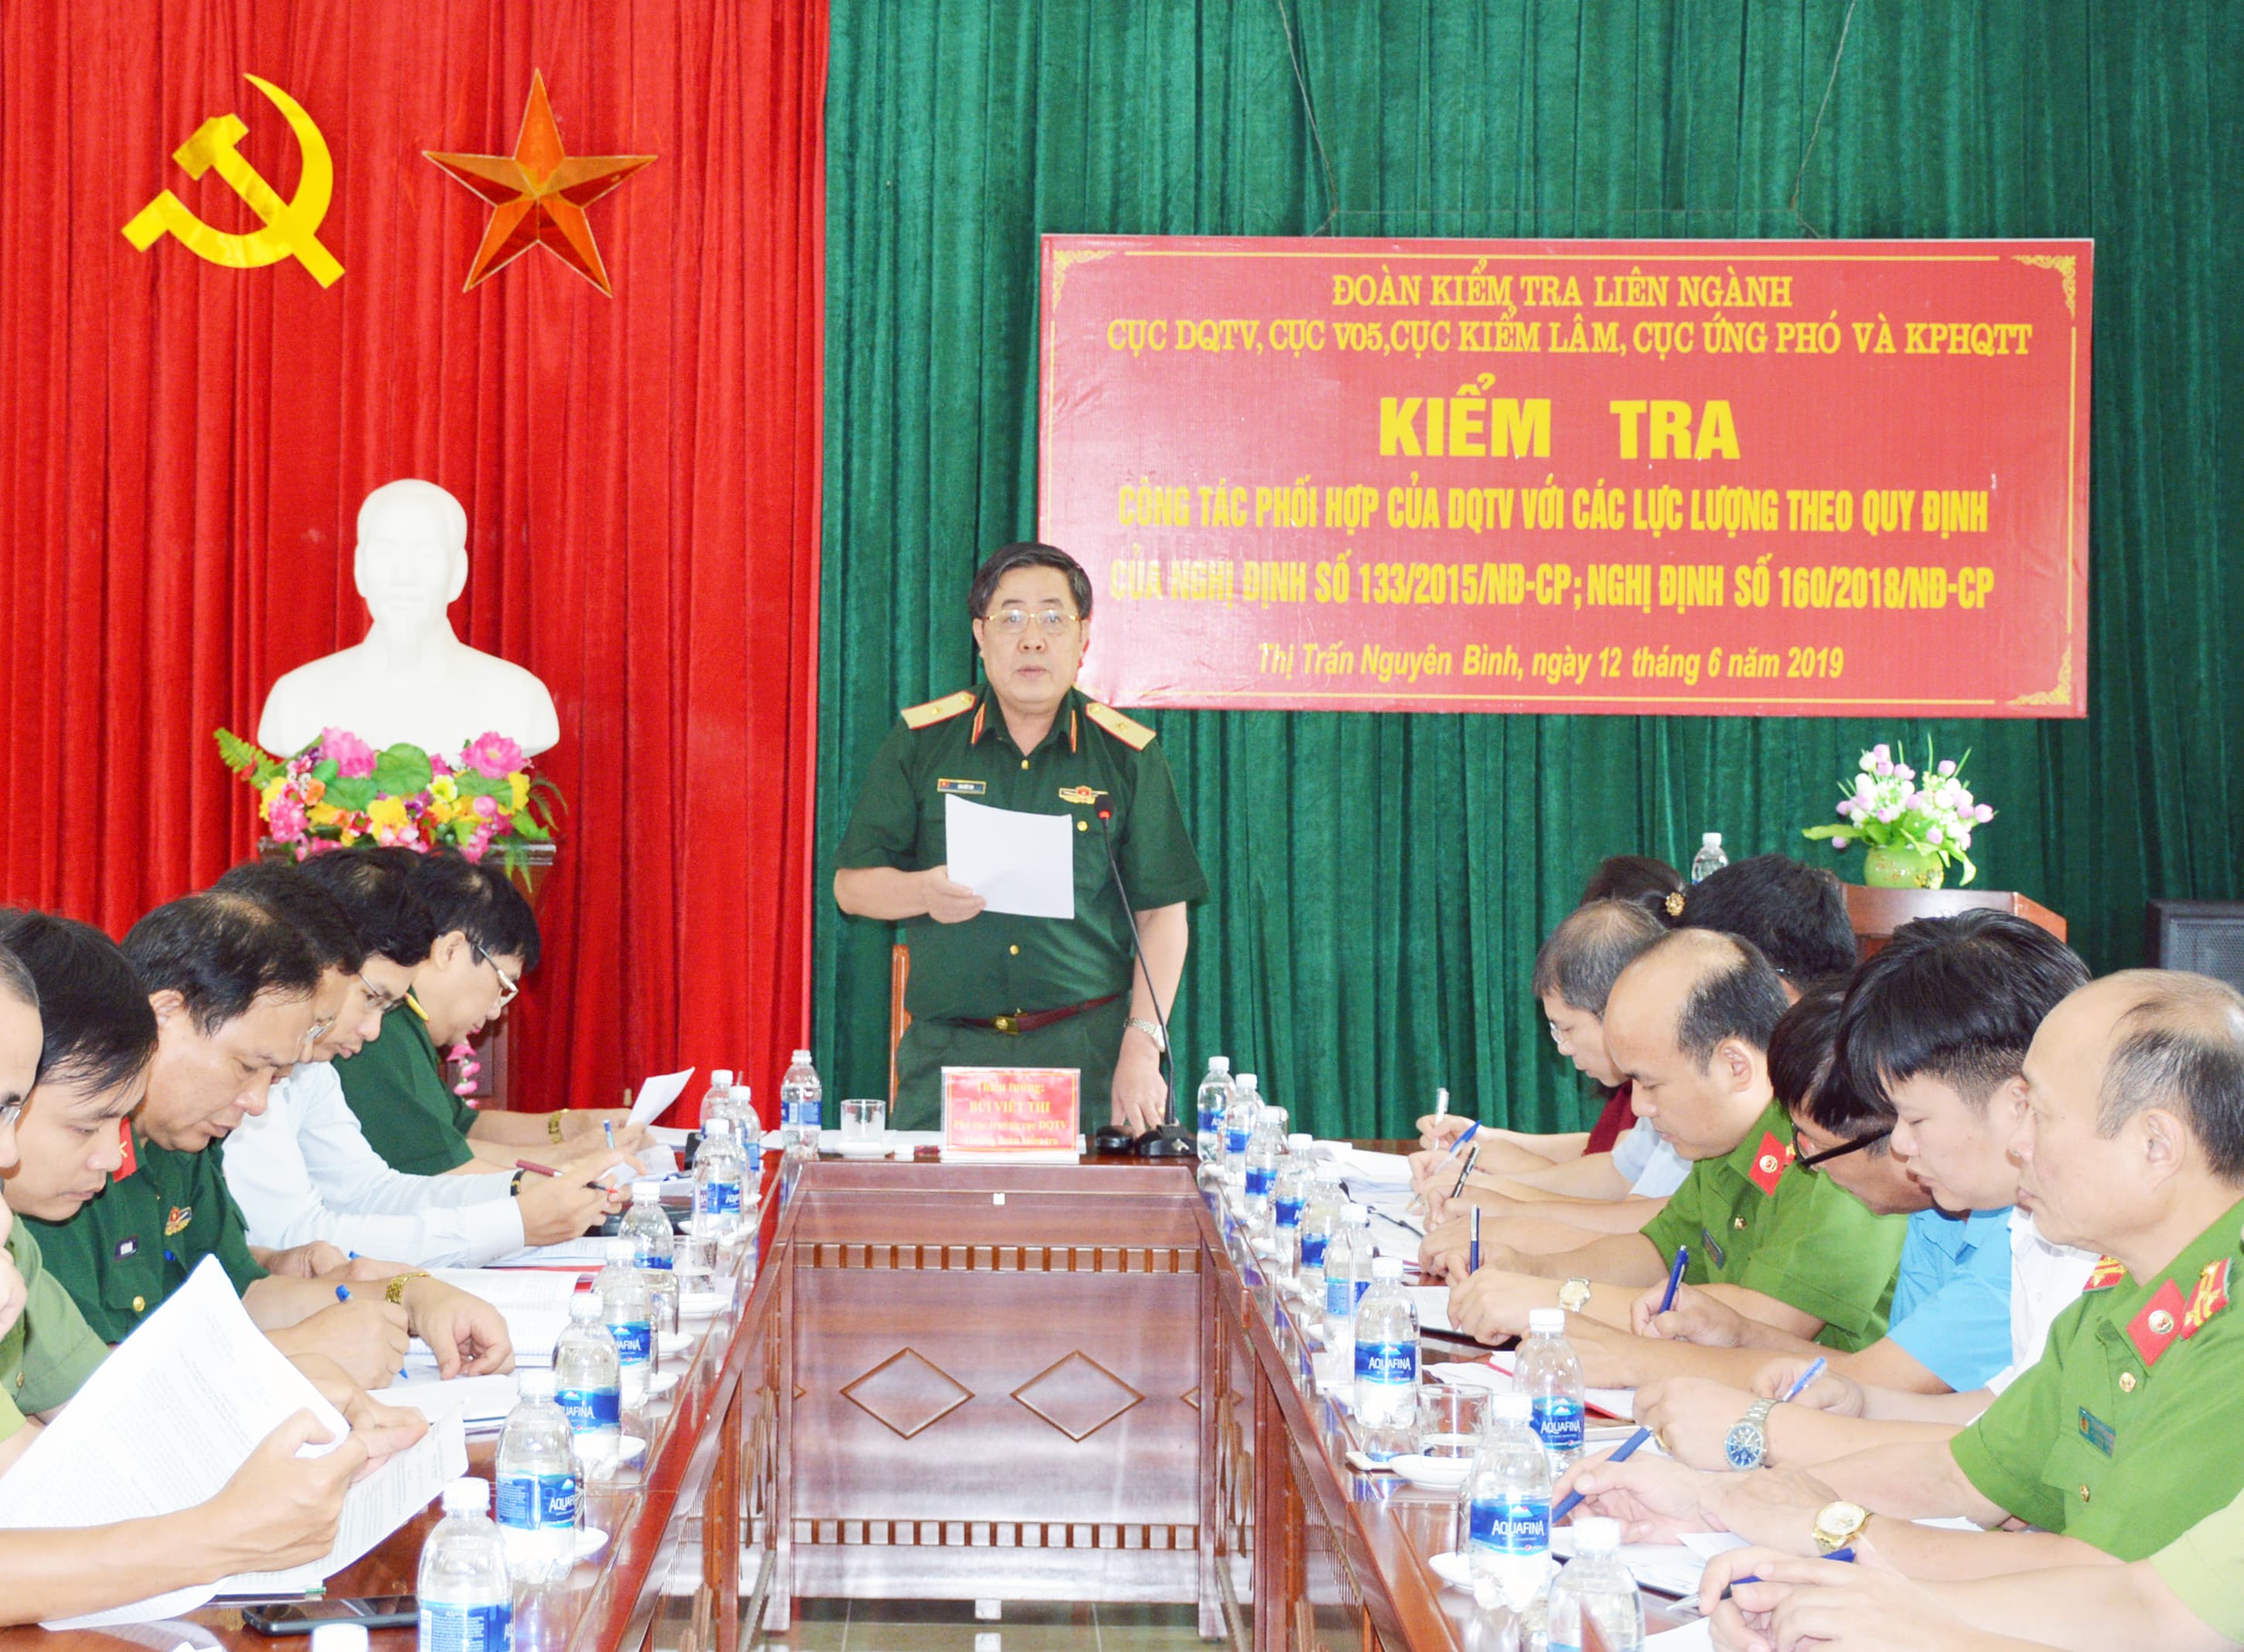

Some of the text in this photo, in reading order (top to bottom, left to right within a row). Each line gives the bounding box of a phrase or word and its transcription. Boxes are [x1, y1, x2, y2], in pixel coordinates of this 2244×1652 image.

[1333, 258, 1794, 307] ĐOÀN KIỂM TRA LIÊN NGÀNH
[1108, 319, 1167, 357] CỤC
[1176, 319, 1263, 354] DQTV,
[1269, 319, 1325, 357] CỤC
[1458, 306, 1540, 353] KIỂM
[1549, 312, 1627, 357] LÂM,
[1633, 322, 1694, 360] CỤC
[1703, 311, 1768, 353] ỨNG
[1775, 309, 1842, 354] PHÓ
[1852, 312, 1897, 354] VÀ
[1904, 322, 2034, 357] KPHQTT
[1380, 372, 1741, 459] KIỂM TRA
[1119, 471, 1988, 539] CÔNG TÁC PHỐI HỢP CỦA DQTV VỚI CÁC LỰC LƯỢNG THEO QUY ĐỊNH
[1110, 544, 1163, 600] CỦA
[1171, 560, 1234, 609] NGHỊ
[1242, 561, 1307, 609] ĐỊNH
[1314, 548, 1352, 603] SỐ
[1587, 564, 1652, 614] NGHỊ
[1658, 564, 1725, 615] ĐỊNH
[1734, 552, 1774, 607] SỐ
[1779, 565, 1995, 609] 160/2018/NĐ-CP
[1259, 641, 1845, 686] Thị Trấn Nguyên Bình, ngày 12 tháng 6 năm 2019
[1368, 1356, 1412, 1371] AQUAFINA
[1540, 1419, 1581, 1435] AQUAFINA
[1491, 1519, 1545, 1537] AQUAFINA
